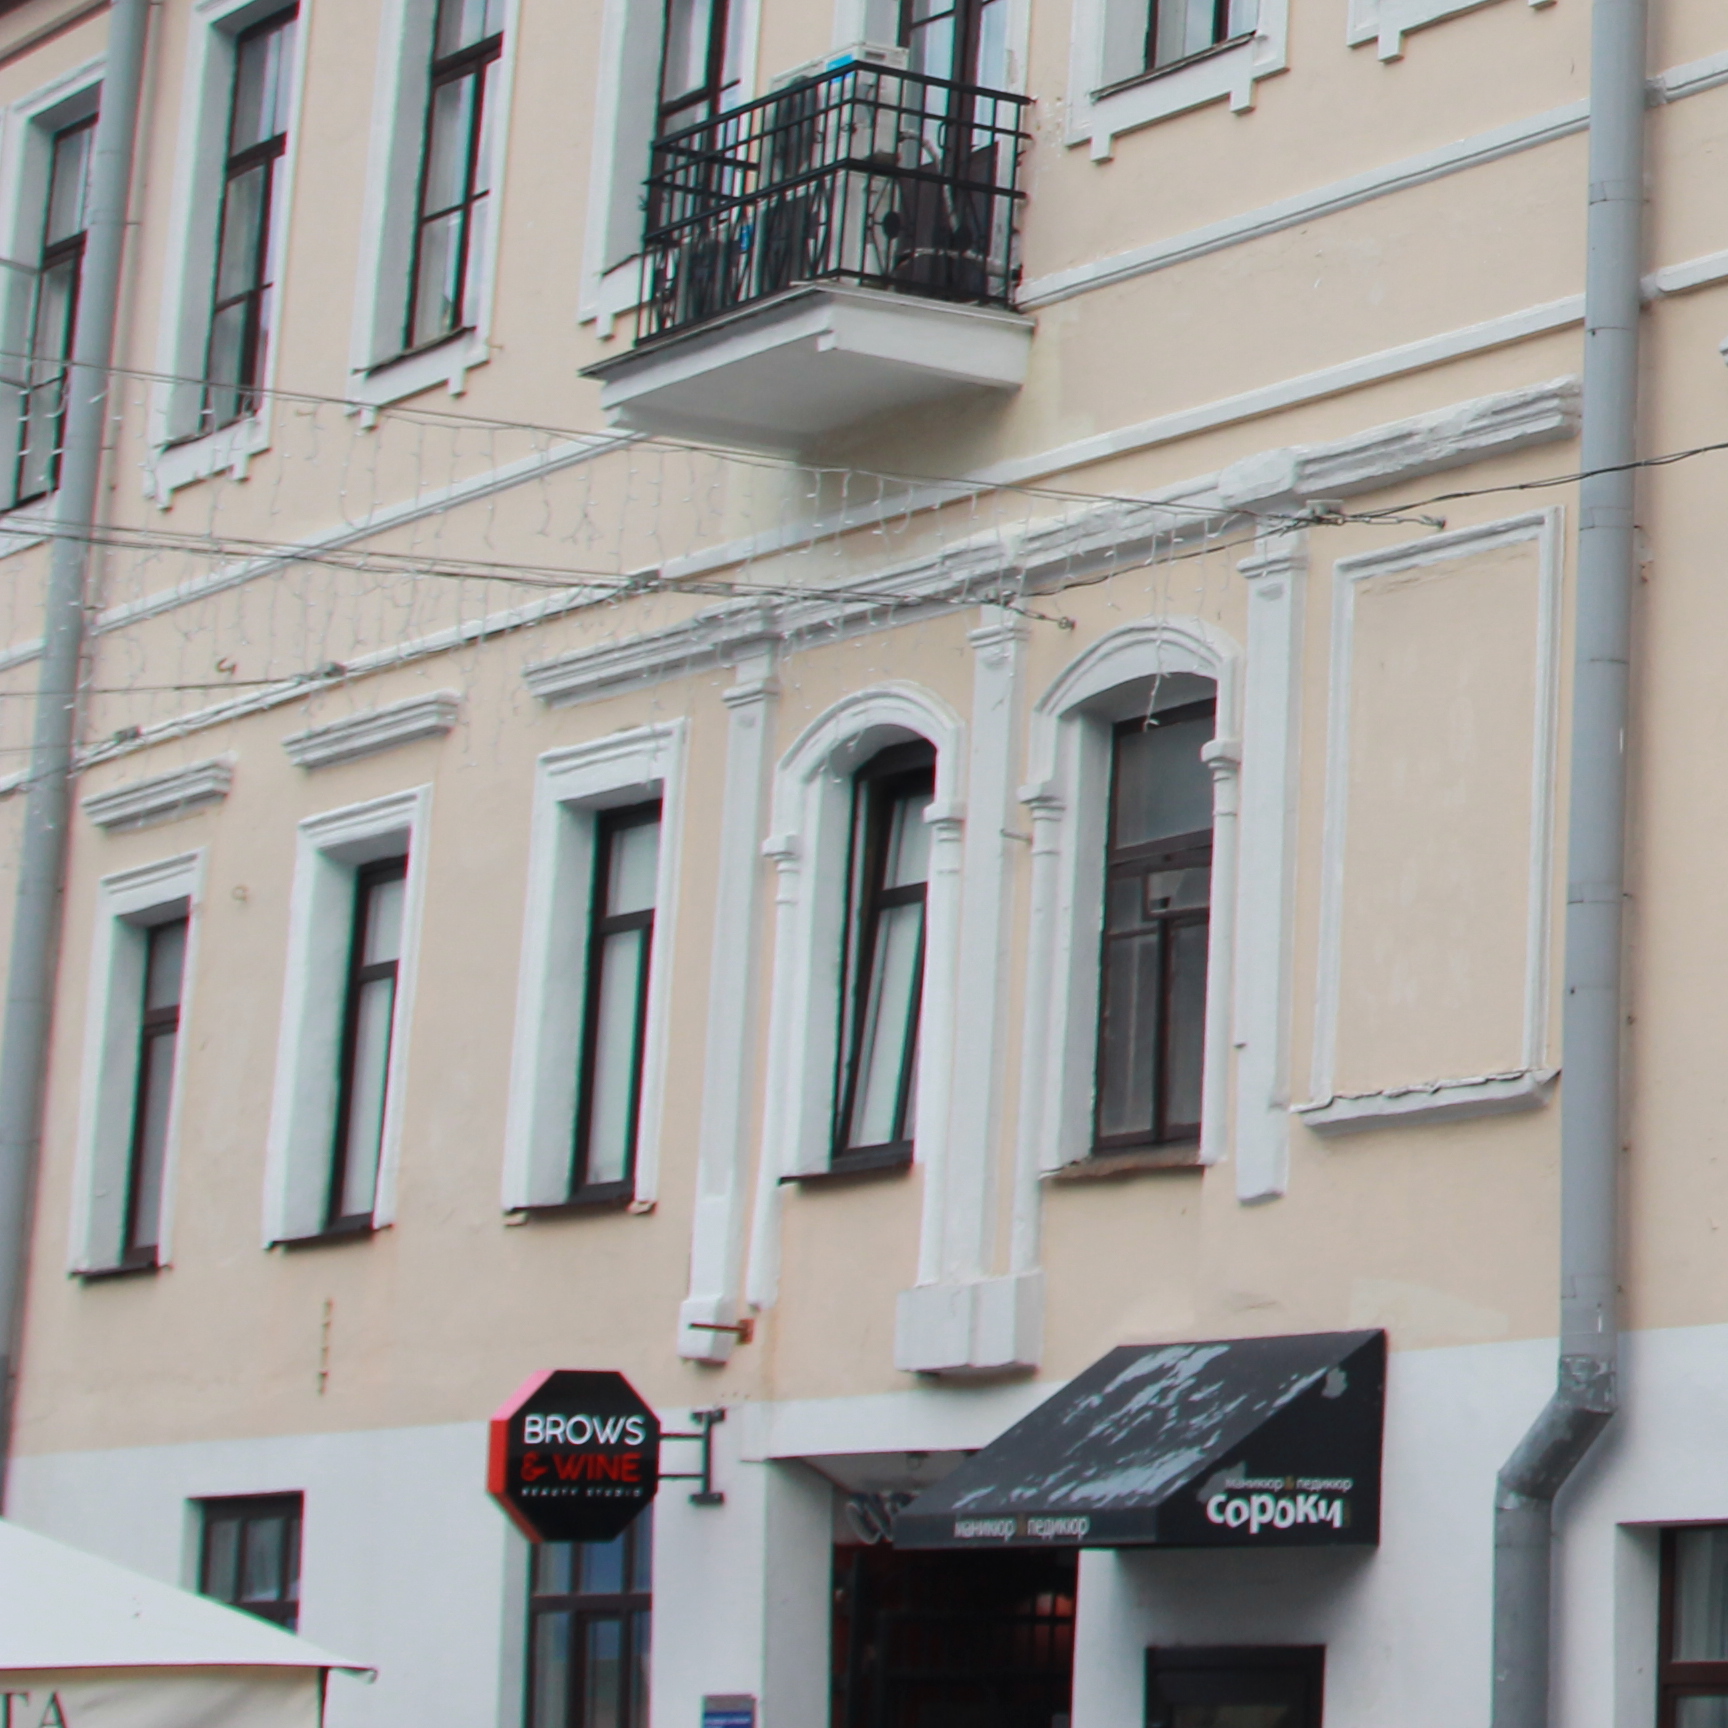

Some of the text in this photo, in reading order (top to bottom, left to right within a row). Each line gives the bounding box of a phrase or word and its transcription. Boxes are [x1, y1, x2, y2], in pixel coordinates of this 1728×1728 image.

[523, 1413, 647, 1446] BROWS
[521, 1450, 643, 1483] & WINE
[1206, 1492, 1344, 1535] сороки
